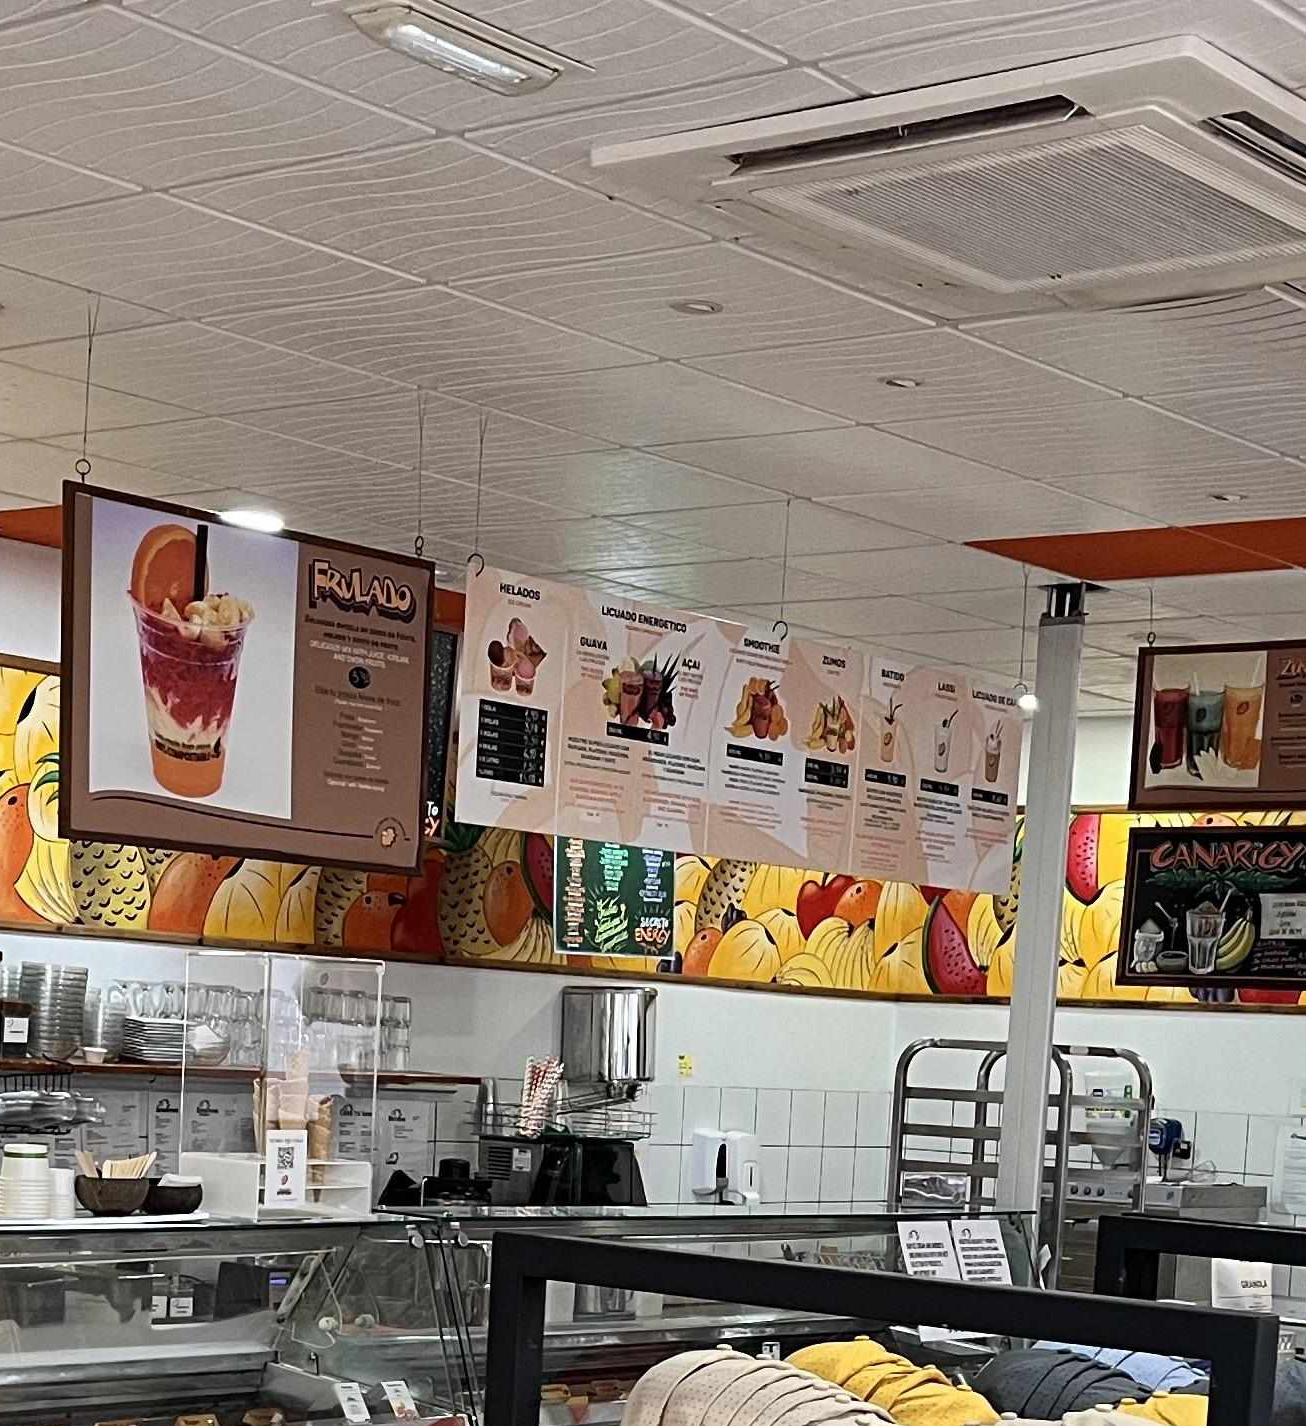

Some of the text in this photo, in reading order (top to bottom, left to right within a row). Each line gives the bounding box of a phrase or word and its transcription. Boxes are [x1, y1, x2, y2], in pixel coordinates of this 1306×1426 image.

[499, 583, 541, 601] HELADOS
[601, 605, 637, 624] LICUADO
[579, 637, 607, 651] GUAVA
